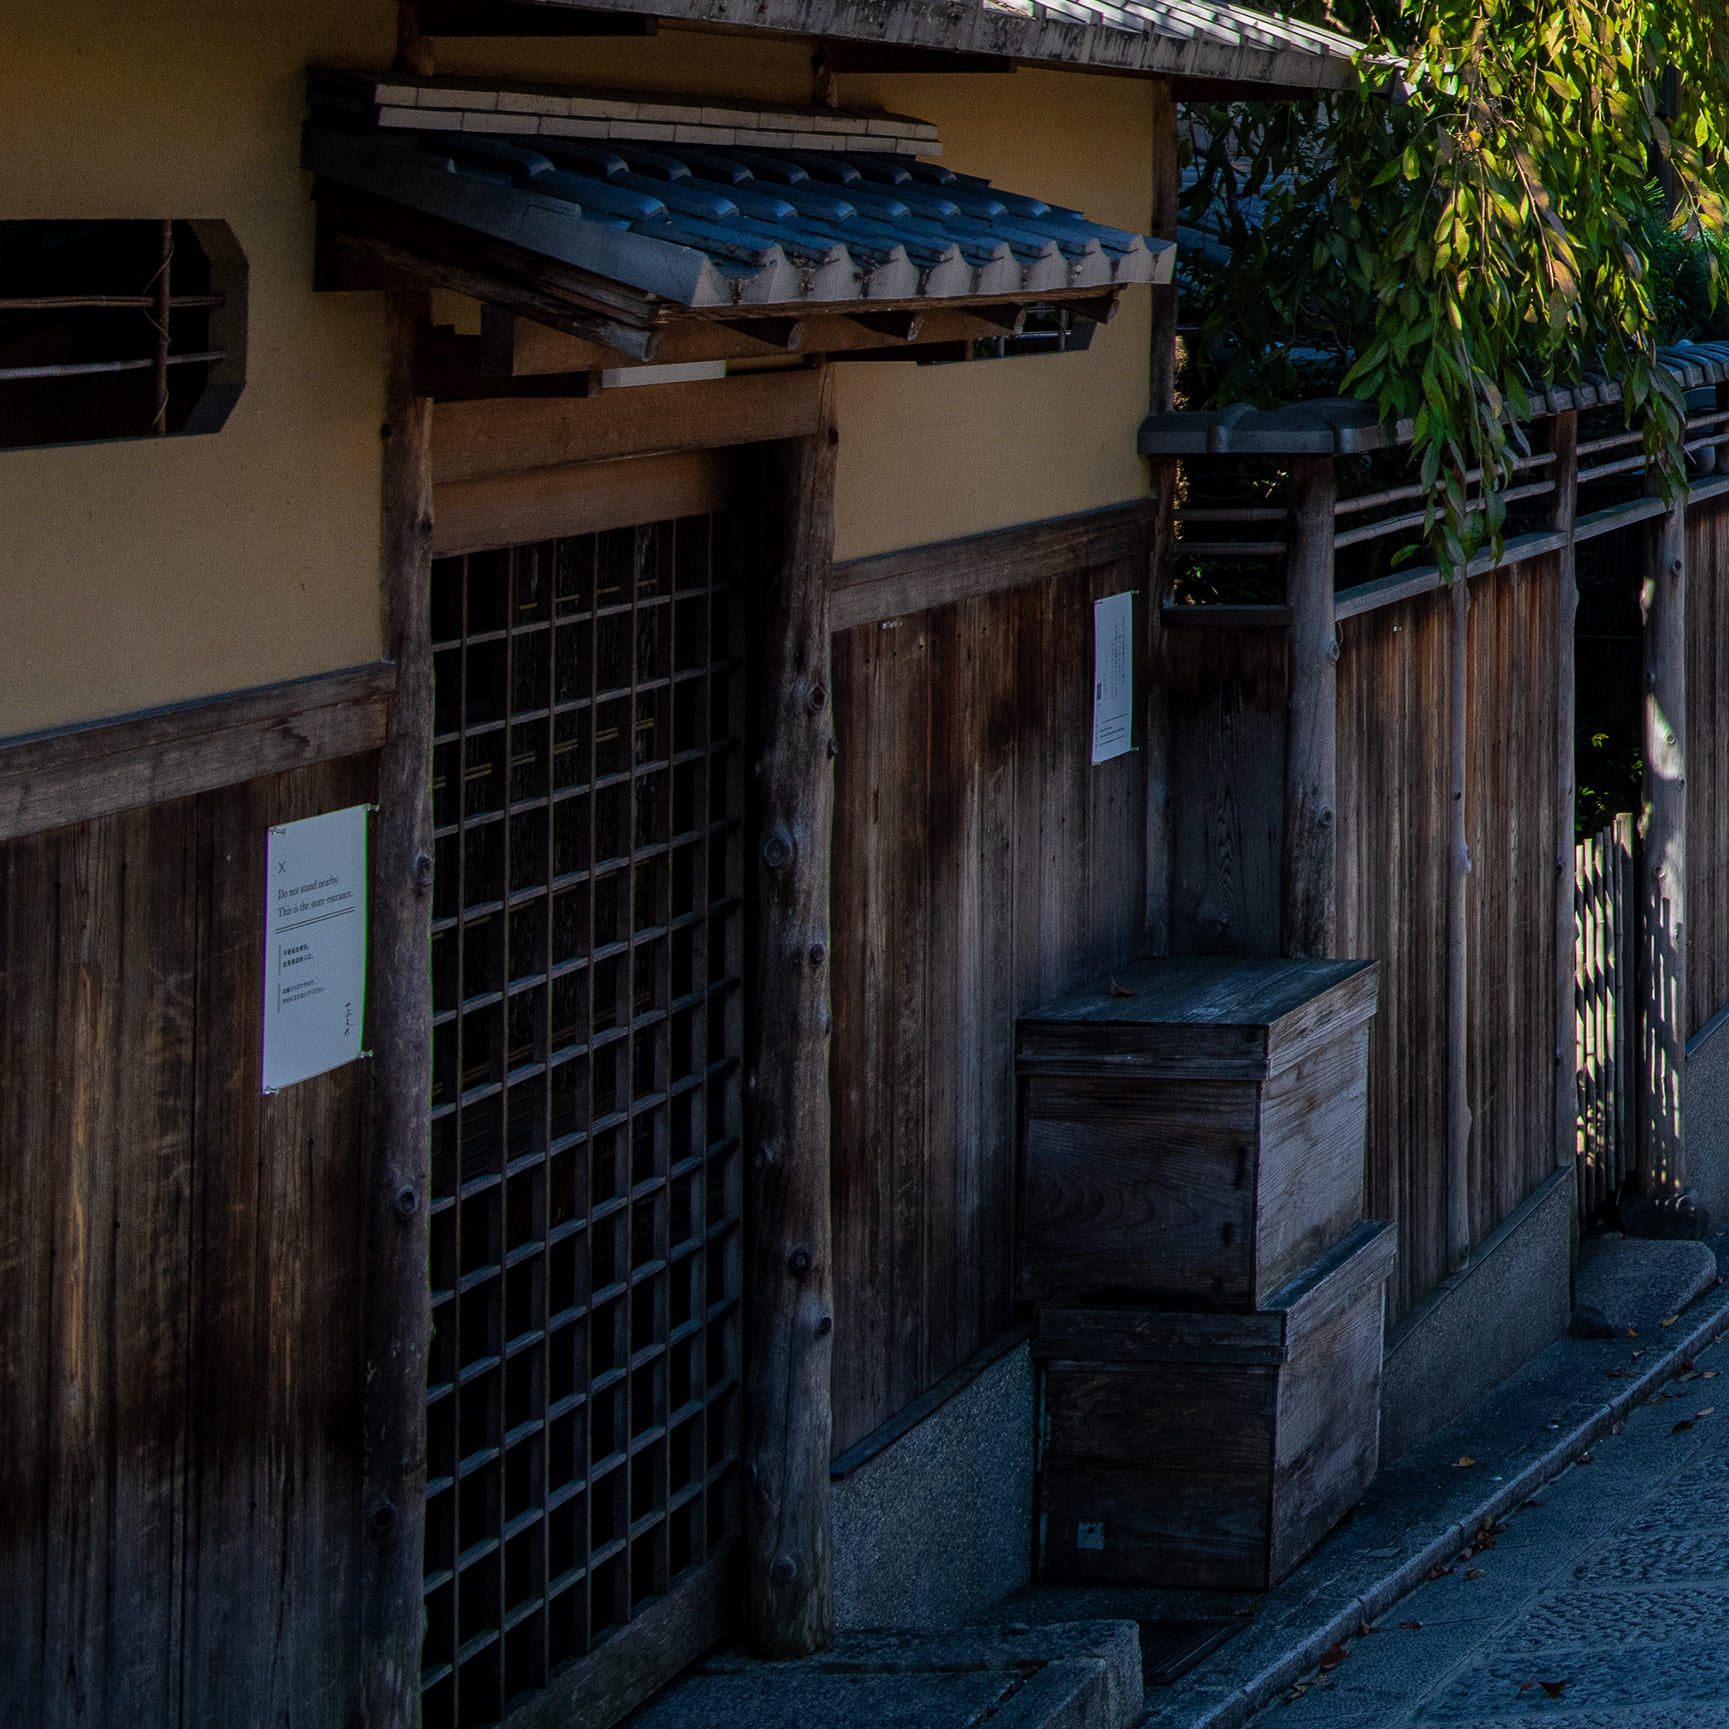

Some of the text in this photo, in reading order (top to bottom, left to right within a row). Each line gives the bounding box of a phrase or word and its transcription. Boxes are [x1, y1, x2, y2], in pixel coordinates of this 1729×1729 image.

[278, 889, 288, 900] Do
[289, 887, 299, 896] not
[300, 880, 317, 893] stand
[278, 906, 293, 917] This
[293, 903, 299, 913] is
[300, 901, 310, 912] the
[311, 898, 326, 909] store
